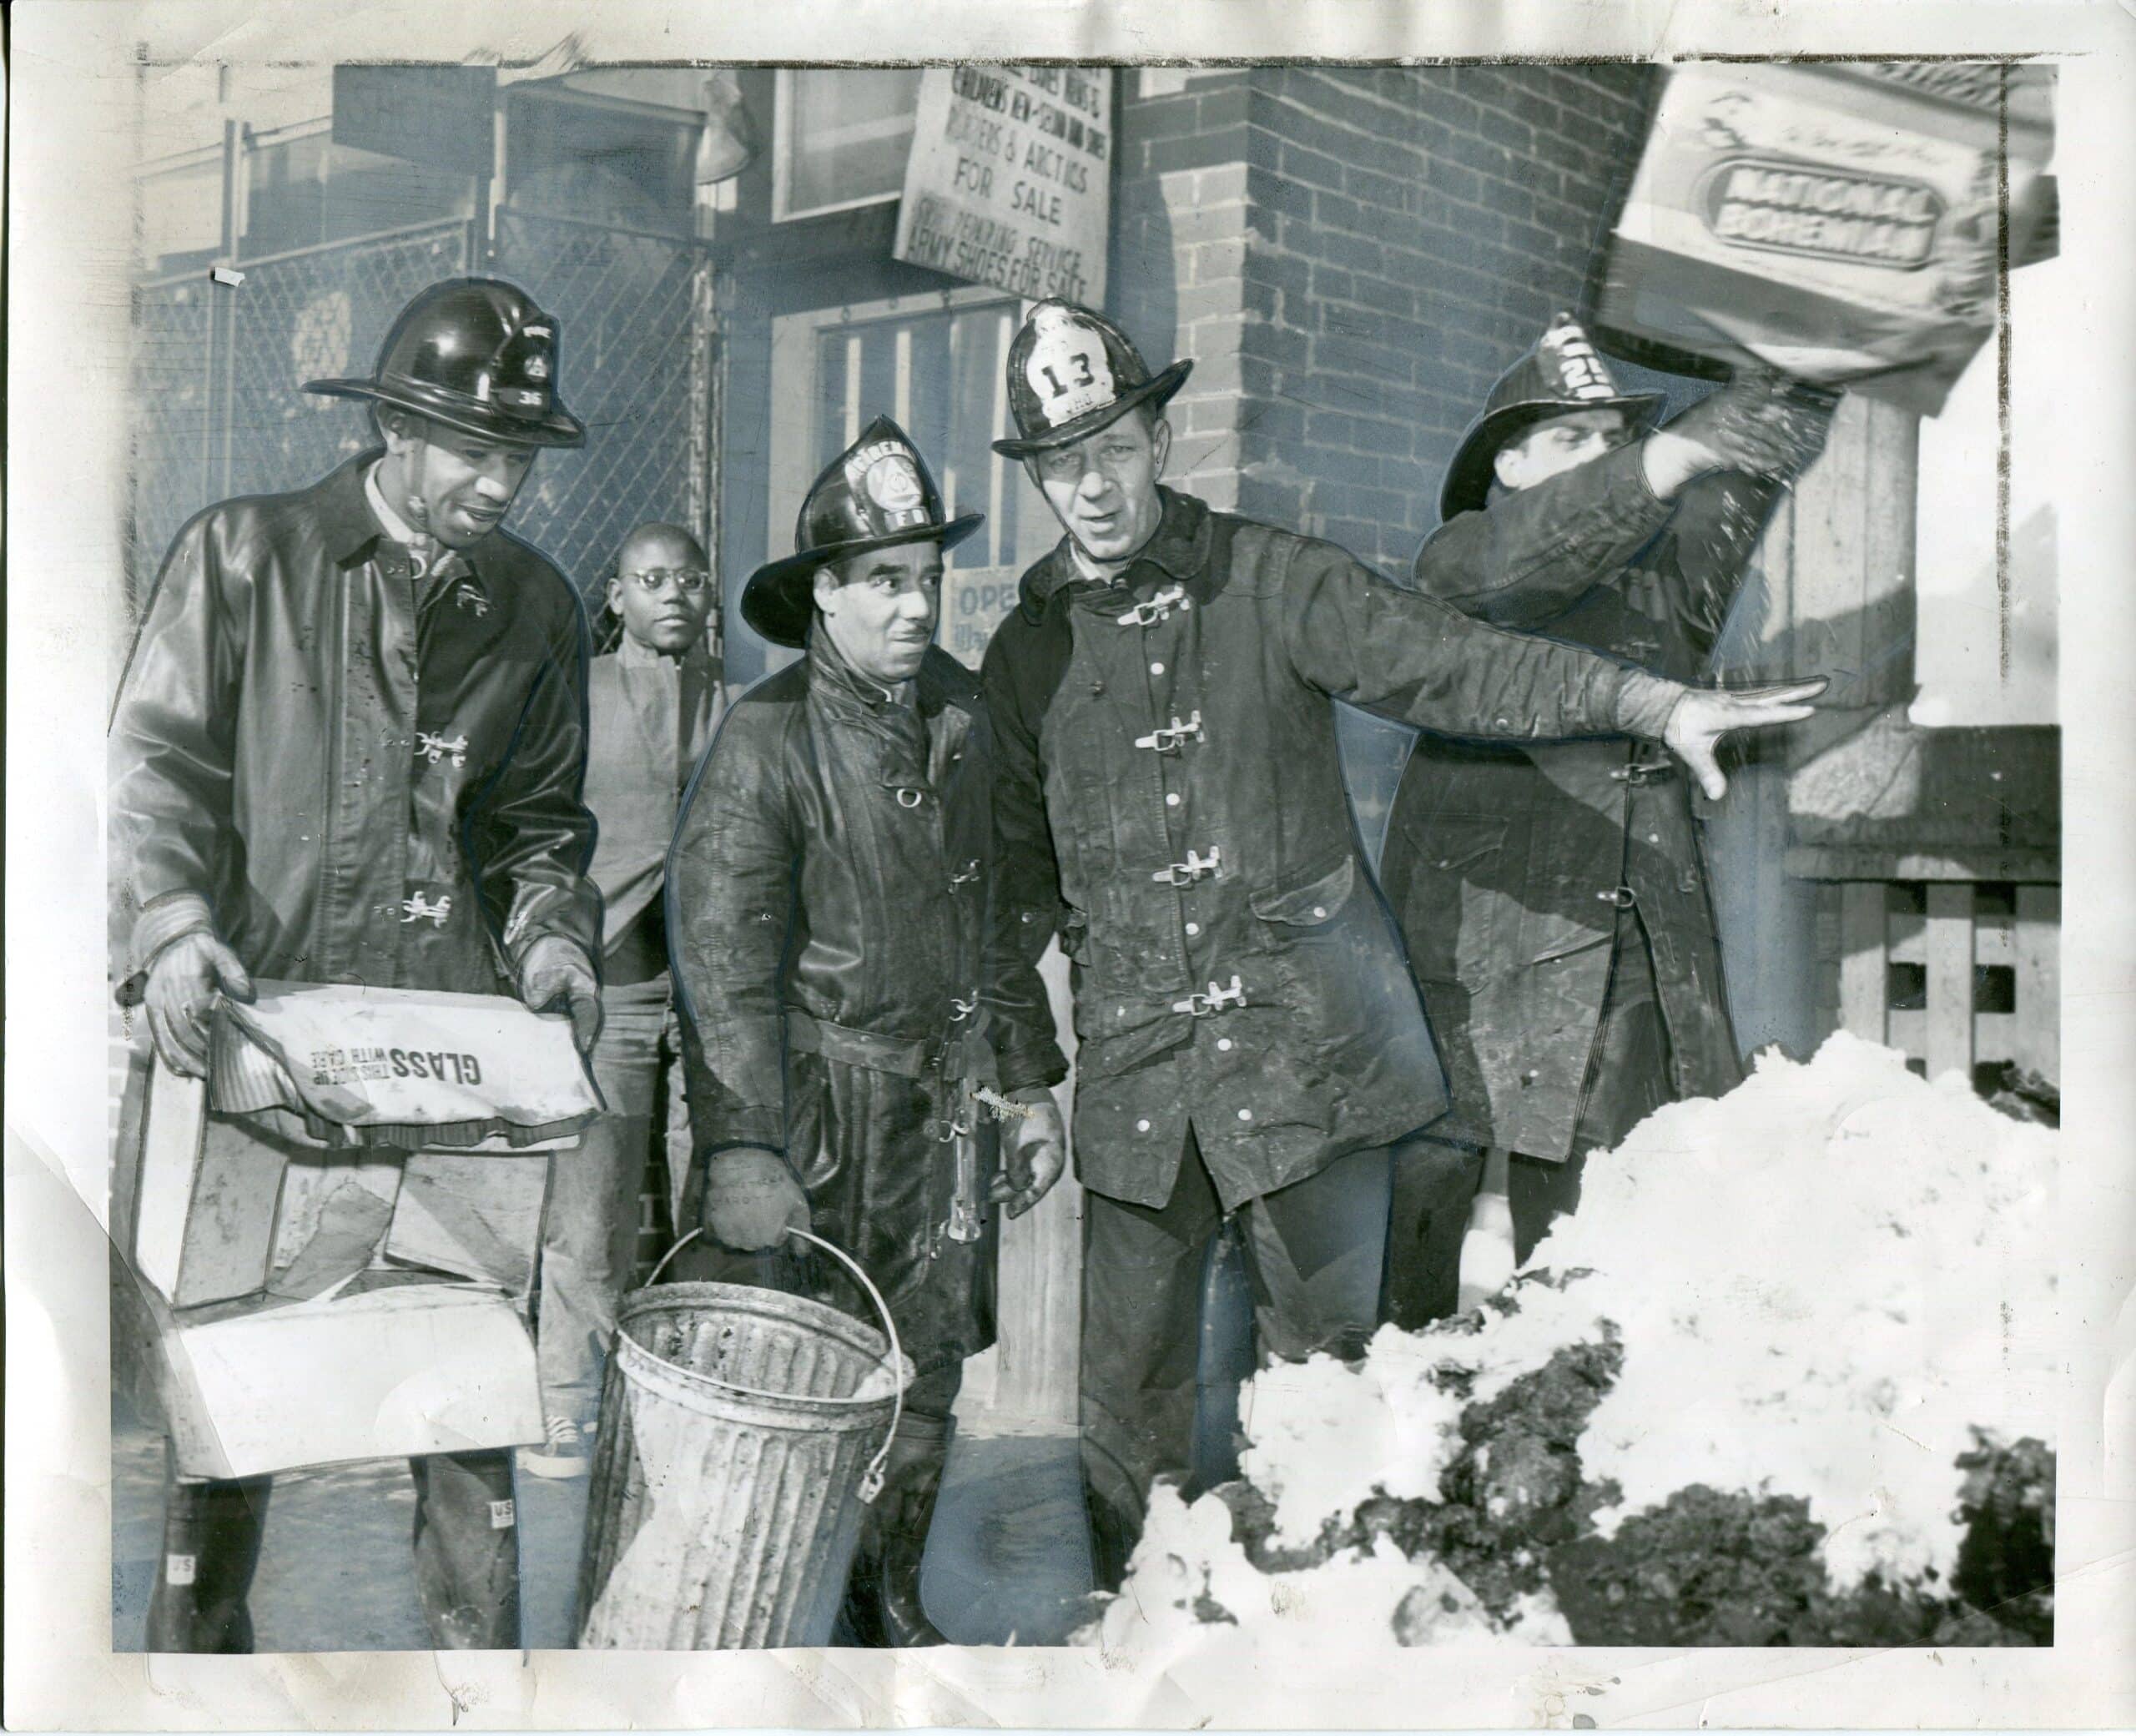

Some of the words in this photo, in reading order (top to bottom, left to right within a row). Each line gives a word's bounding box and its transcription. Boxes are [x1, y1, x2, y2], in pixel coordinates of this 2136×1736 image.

[1024, 140, 1089, 194] ARCTICS
[954, 157, 993, 199] FOR
[1010, 180, 1062, 226] SALE
[908, 225, 955, 269] ARMY
[954, 240, 1010, 287] SHOES
[1009, 257, 1042, 295] FOR
[1041, 352, 1095, 398] 13
[960, 585, 1016, 616] OPE
[351, 1047, 388, 1063] WITH
[360, 1062, 390, 1079] THIS
[390, 1048, 481, 1085] GLASS
[314, 1069, 330, 1085] UP
[493, 1501, 513, 1517] US
